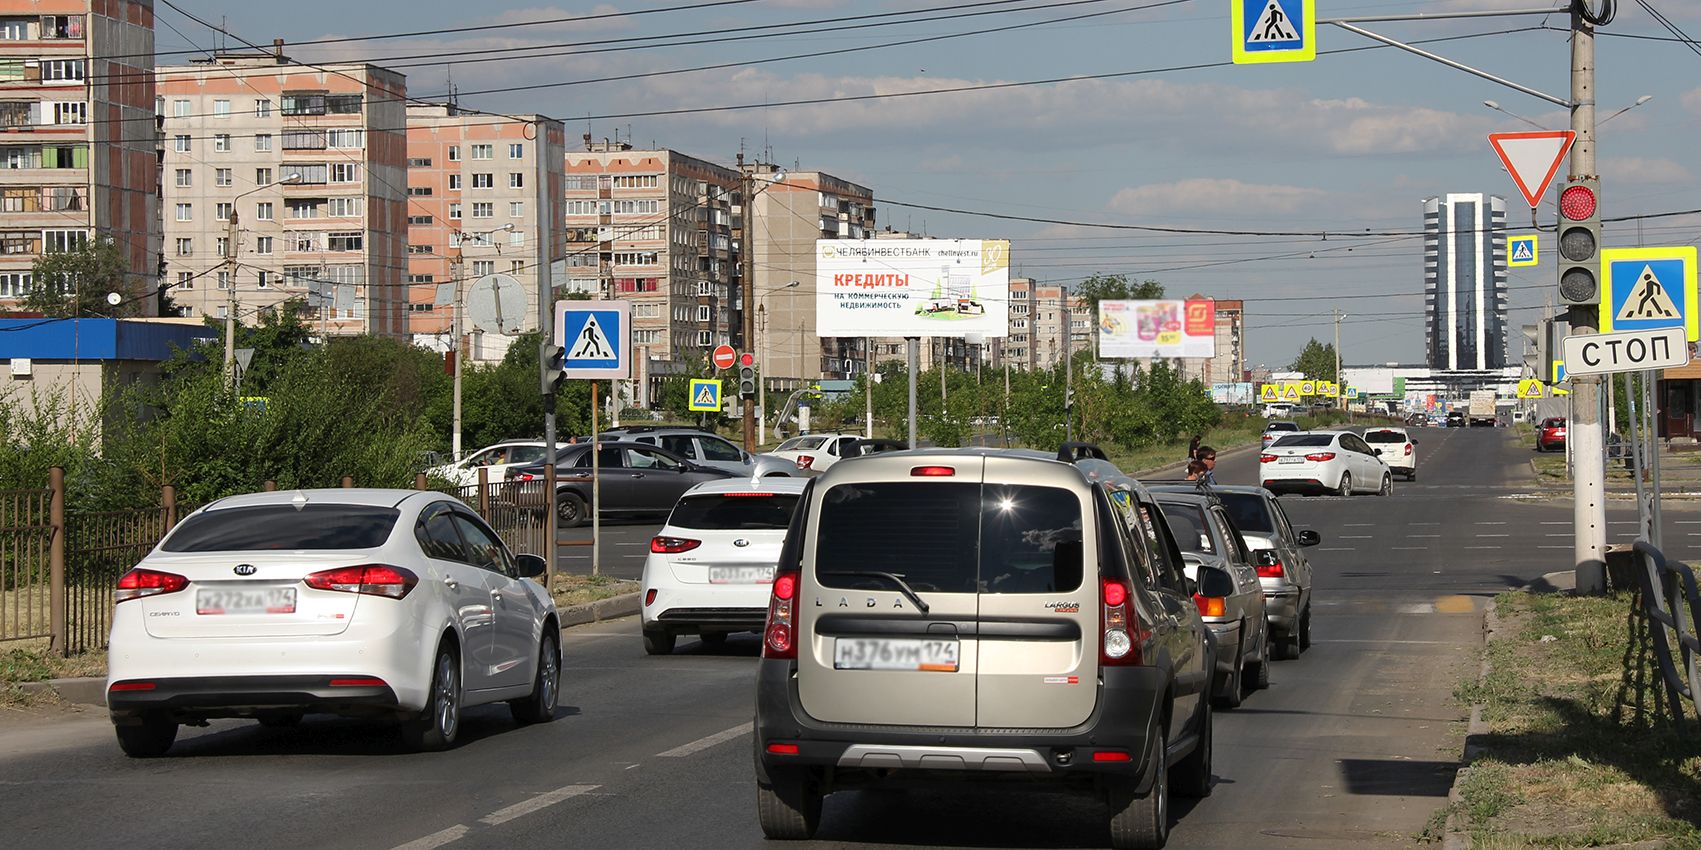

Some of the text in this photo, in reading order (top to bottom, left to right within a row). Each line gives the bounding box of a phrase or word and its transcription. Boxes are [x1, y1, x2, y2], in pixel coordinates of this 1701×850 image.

[836, 247, 931, 257] ЧЕЛЯБИНВЕСТБАНК
[938, 248, 979, 257] chelinvest.ru
[834, 273, 909, 289] КРЕДИТЫ
[848, 292, 910, 300] КОММЕРЧЕСКУЮ
[840, 302, 902, 310] НЕДВИЖИМОСТЬ
[1582, 336, 1670, 367] СТОП
[236, 565, 254, 574] KIA
[816, 596, 903, 608] LADA
